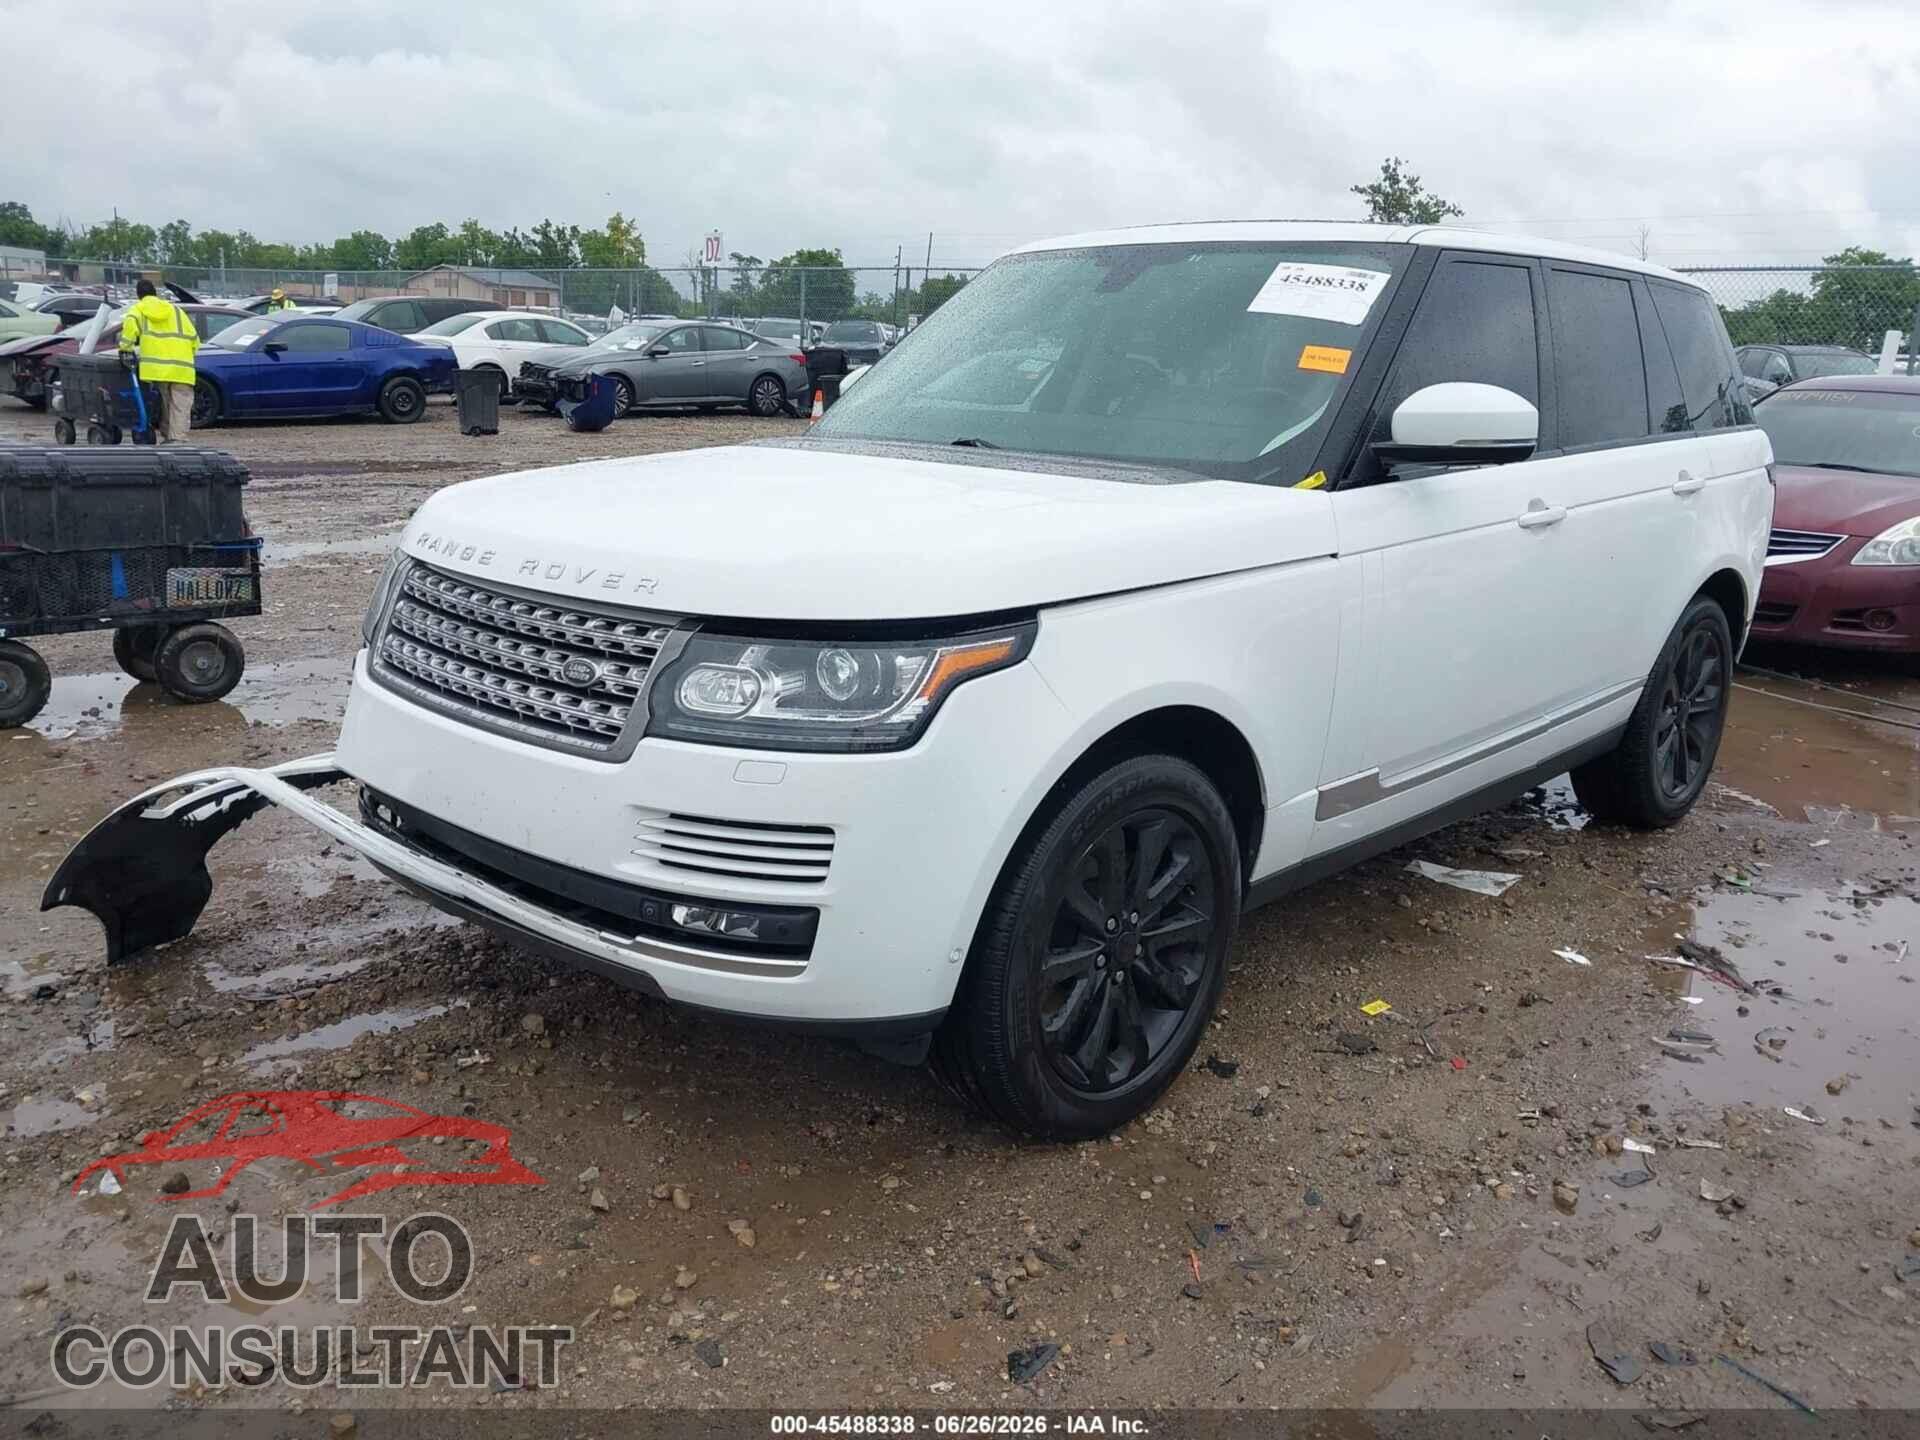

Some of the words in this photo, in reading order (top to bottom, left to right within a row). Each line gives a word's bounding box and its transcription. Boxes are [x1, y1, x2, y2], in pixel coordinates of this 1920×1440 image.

[1279, 273, 1369, 293] 45488338
[416, 532, 497, 566] RANGE
[517, 558, 661, 595] ROVER
